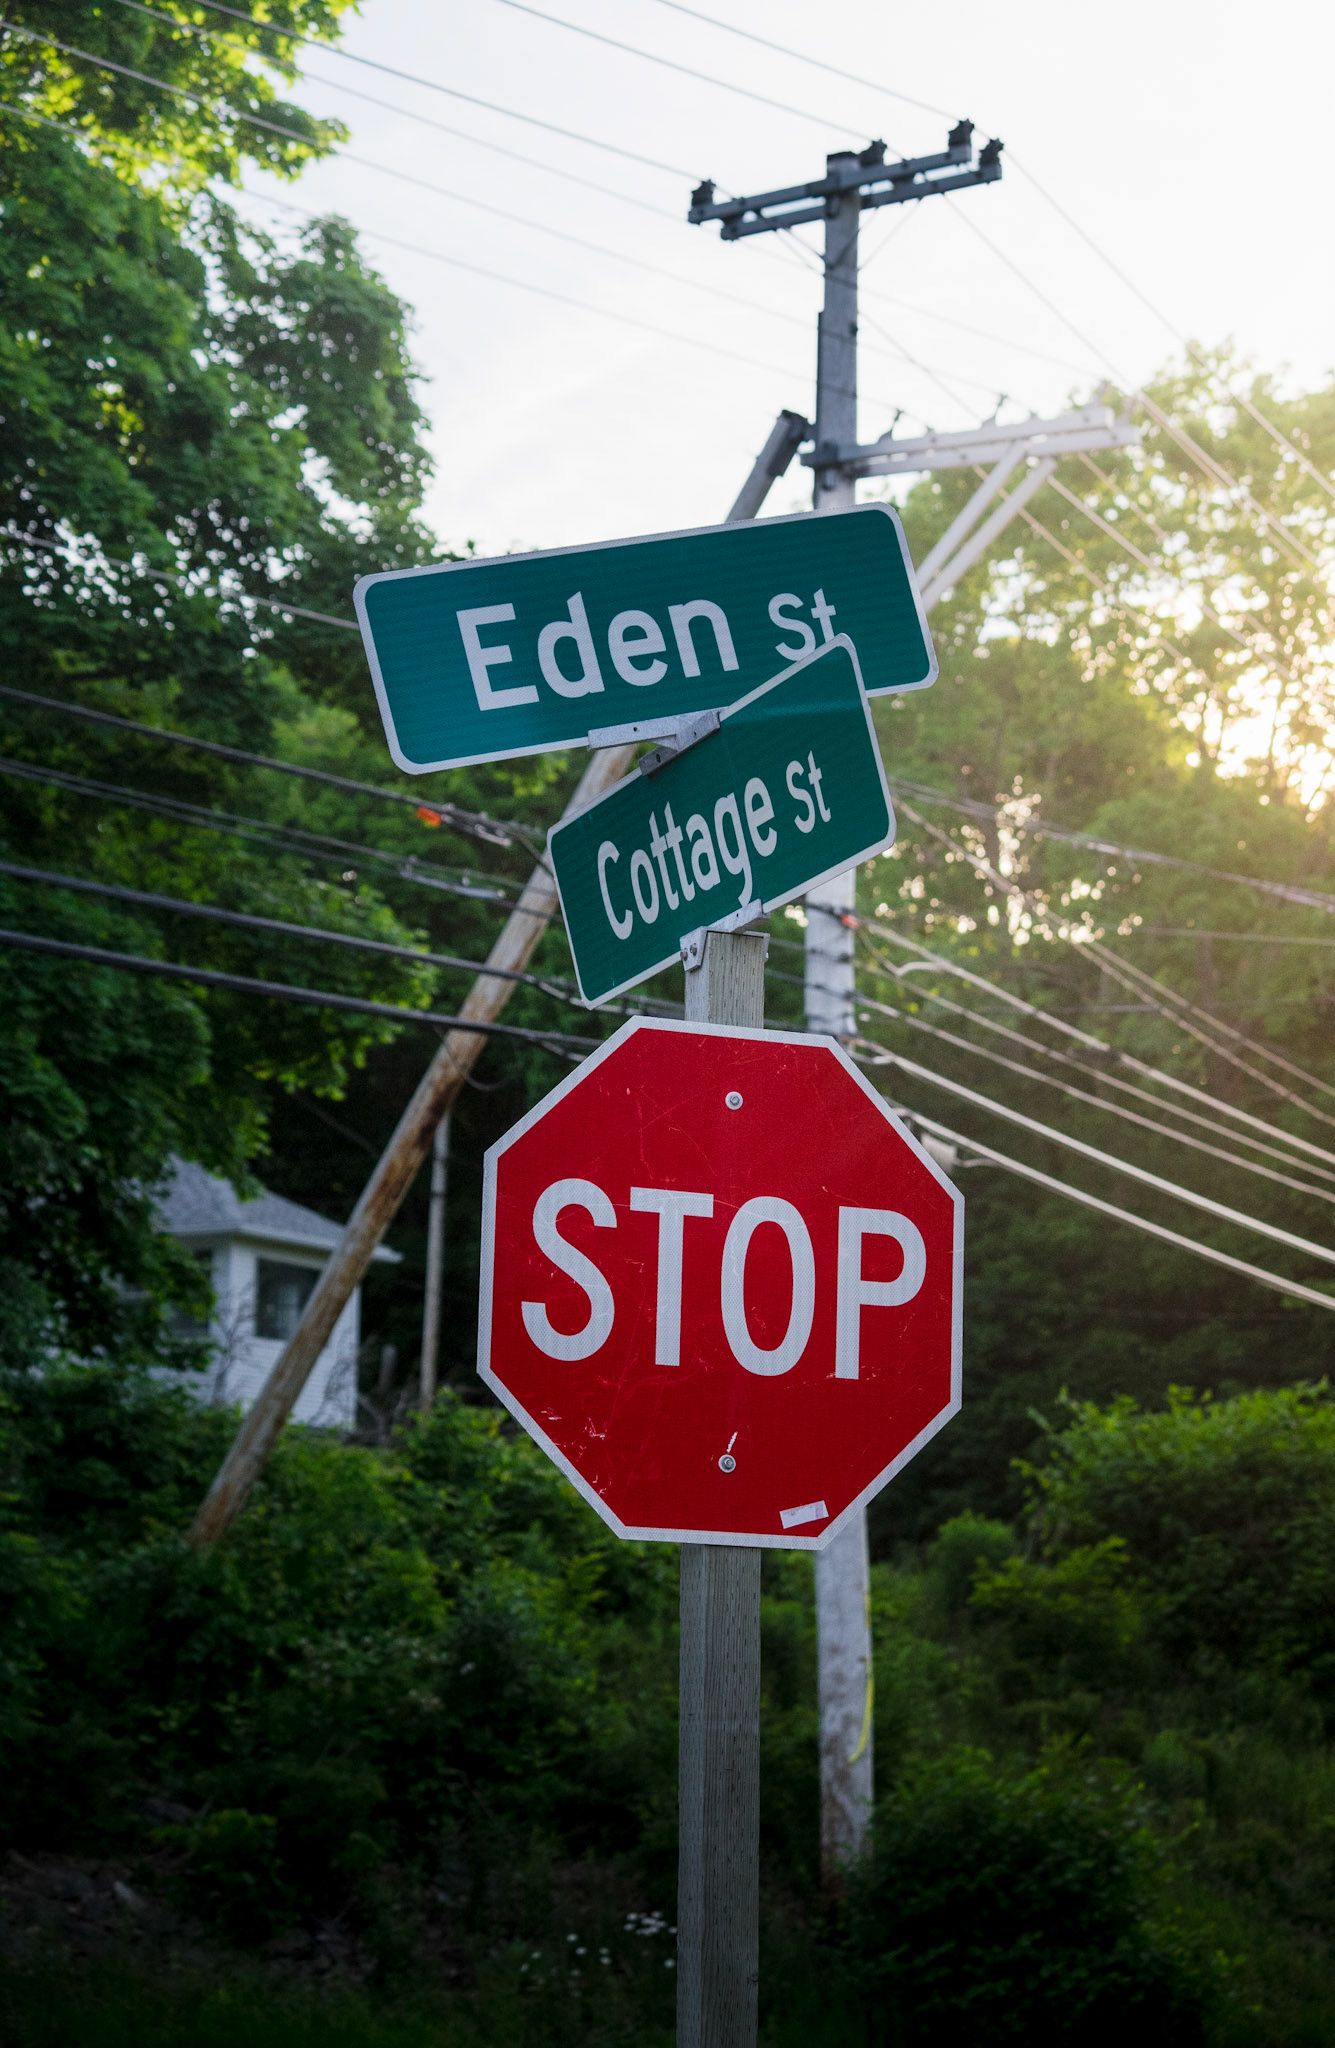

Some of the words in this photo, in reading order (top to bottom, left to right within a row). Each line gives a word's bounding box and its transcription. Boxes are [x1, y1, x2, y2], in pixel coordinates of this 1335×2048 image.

[456, 591, 740, 711] Eden
[768, 588, 836, 661] St
[597, 776, 778, 940] Cottage
[786, 750, 832, 833] St
[521, 1178, 927, 1380] STOP
